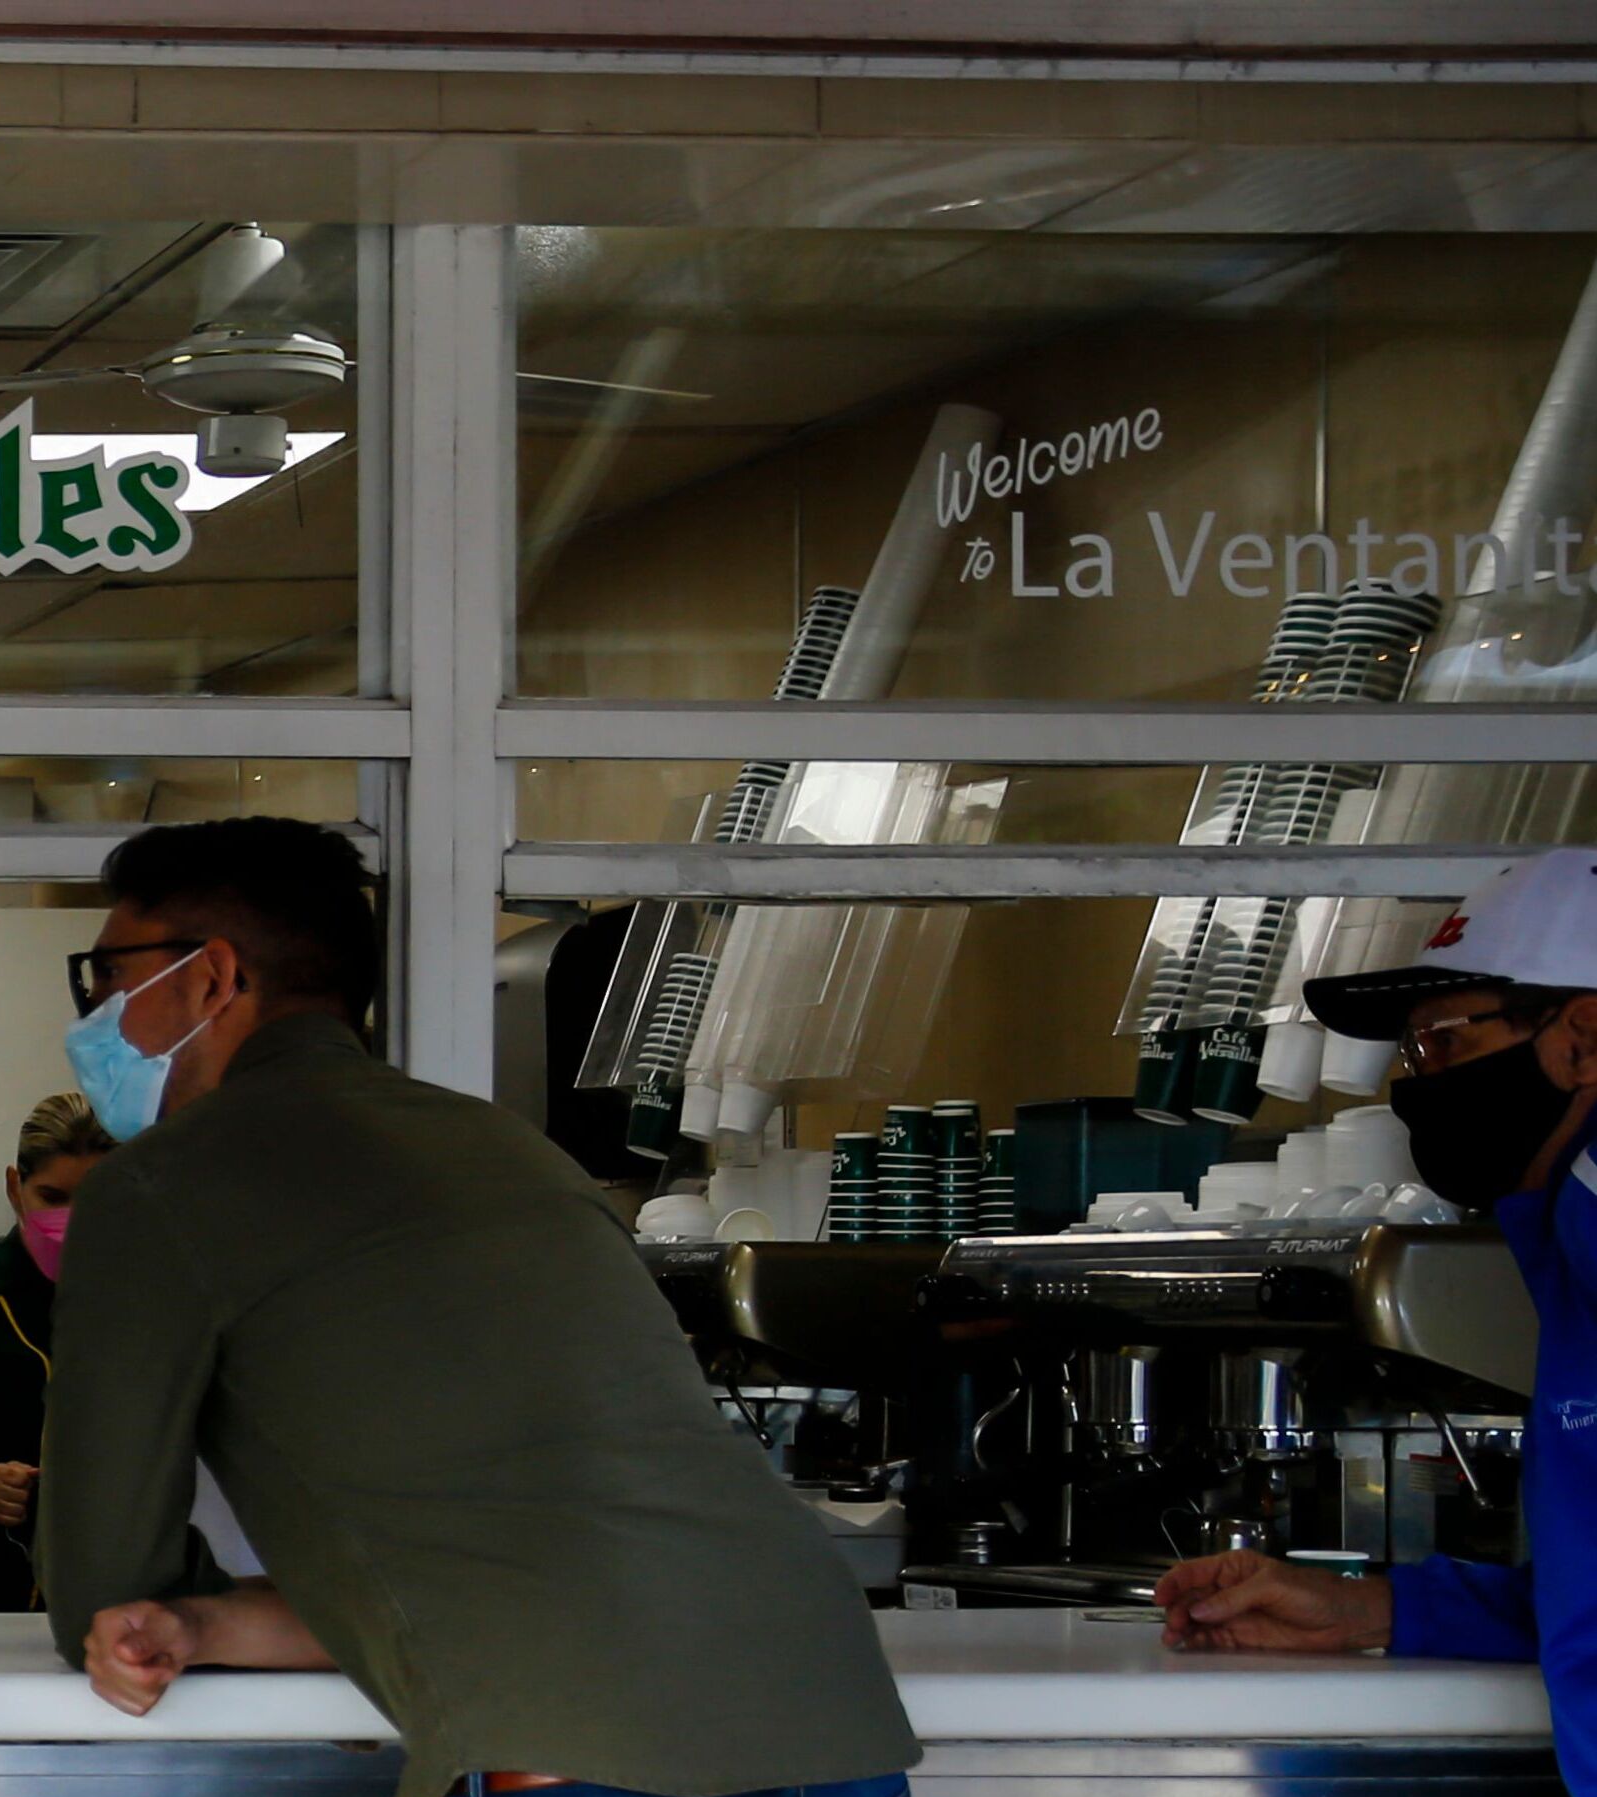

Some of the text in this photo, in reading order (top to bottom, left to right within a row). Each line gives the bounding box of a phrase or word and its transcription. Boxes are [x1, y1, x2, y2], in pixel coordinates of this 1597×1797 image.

[936, 408, 1163, 529] Welcome
[1011, 511, 1597, 598] La Ventanit
[1266, 1237, 1353, 1255] FUTURMAT
